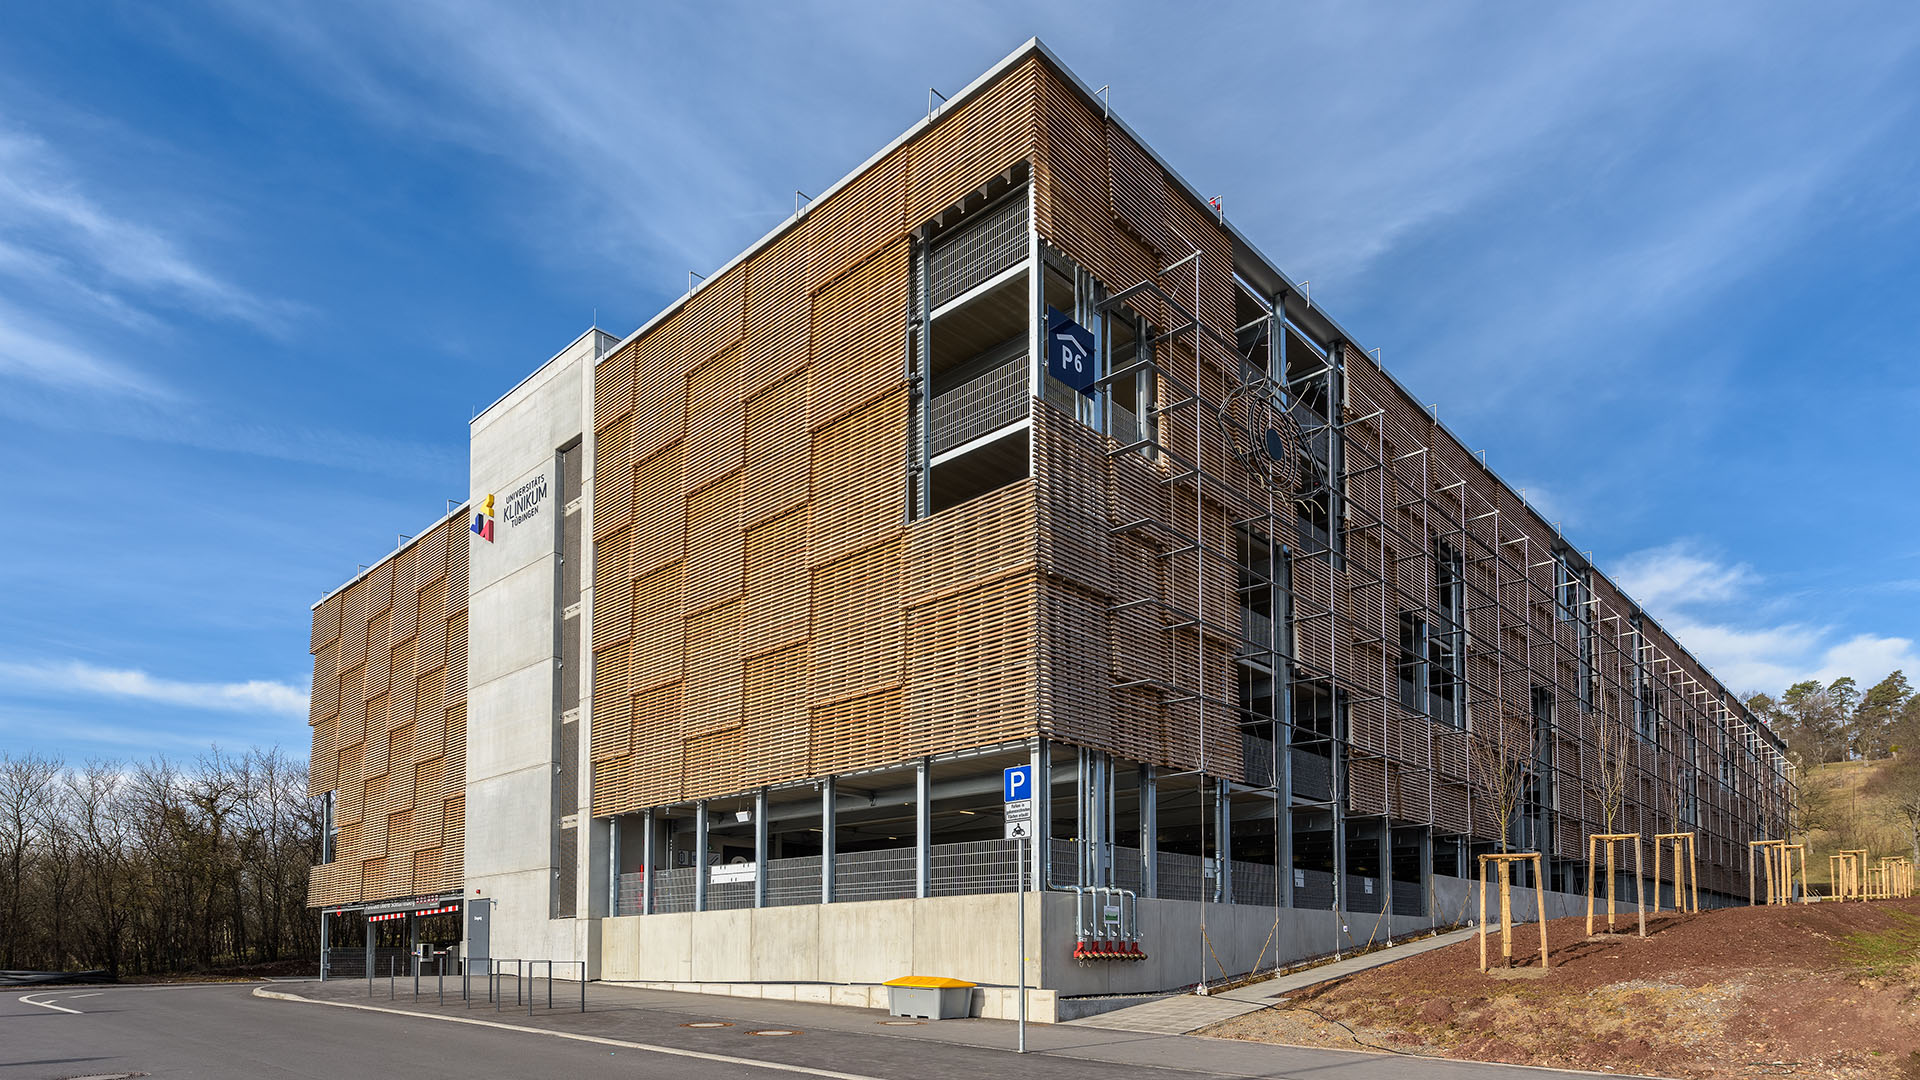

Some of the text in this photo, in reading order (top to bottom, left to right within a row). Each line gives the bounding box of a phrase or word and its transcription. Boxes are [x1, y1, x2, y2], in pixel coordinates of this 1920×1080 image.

[1062, 345, 1083, 373] P6
[503, 482, 547, 523] KLINIKUM
[506, 474, 545, 504] UNIVERSITÄTS
[511, 505, 539, 528] TÜBINGEN
[1010, 771, 1025, 797] P
